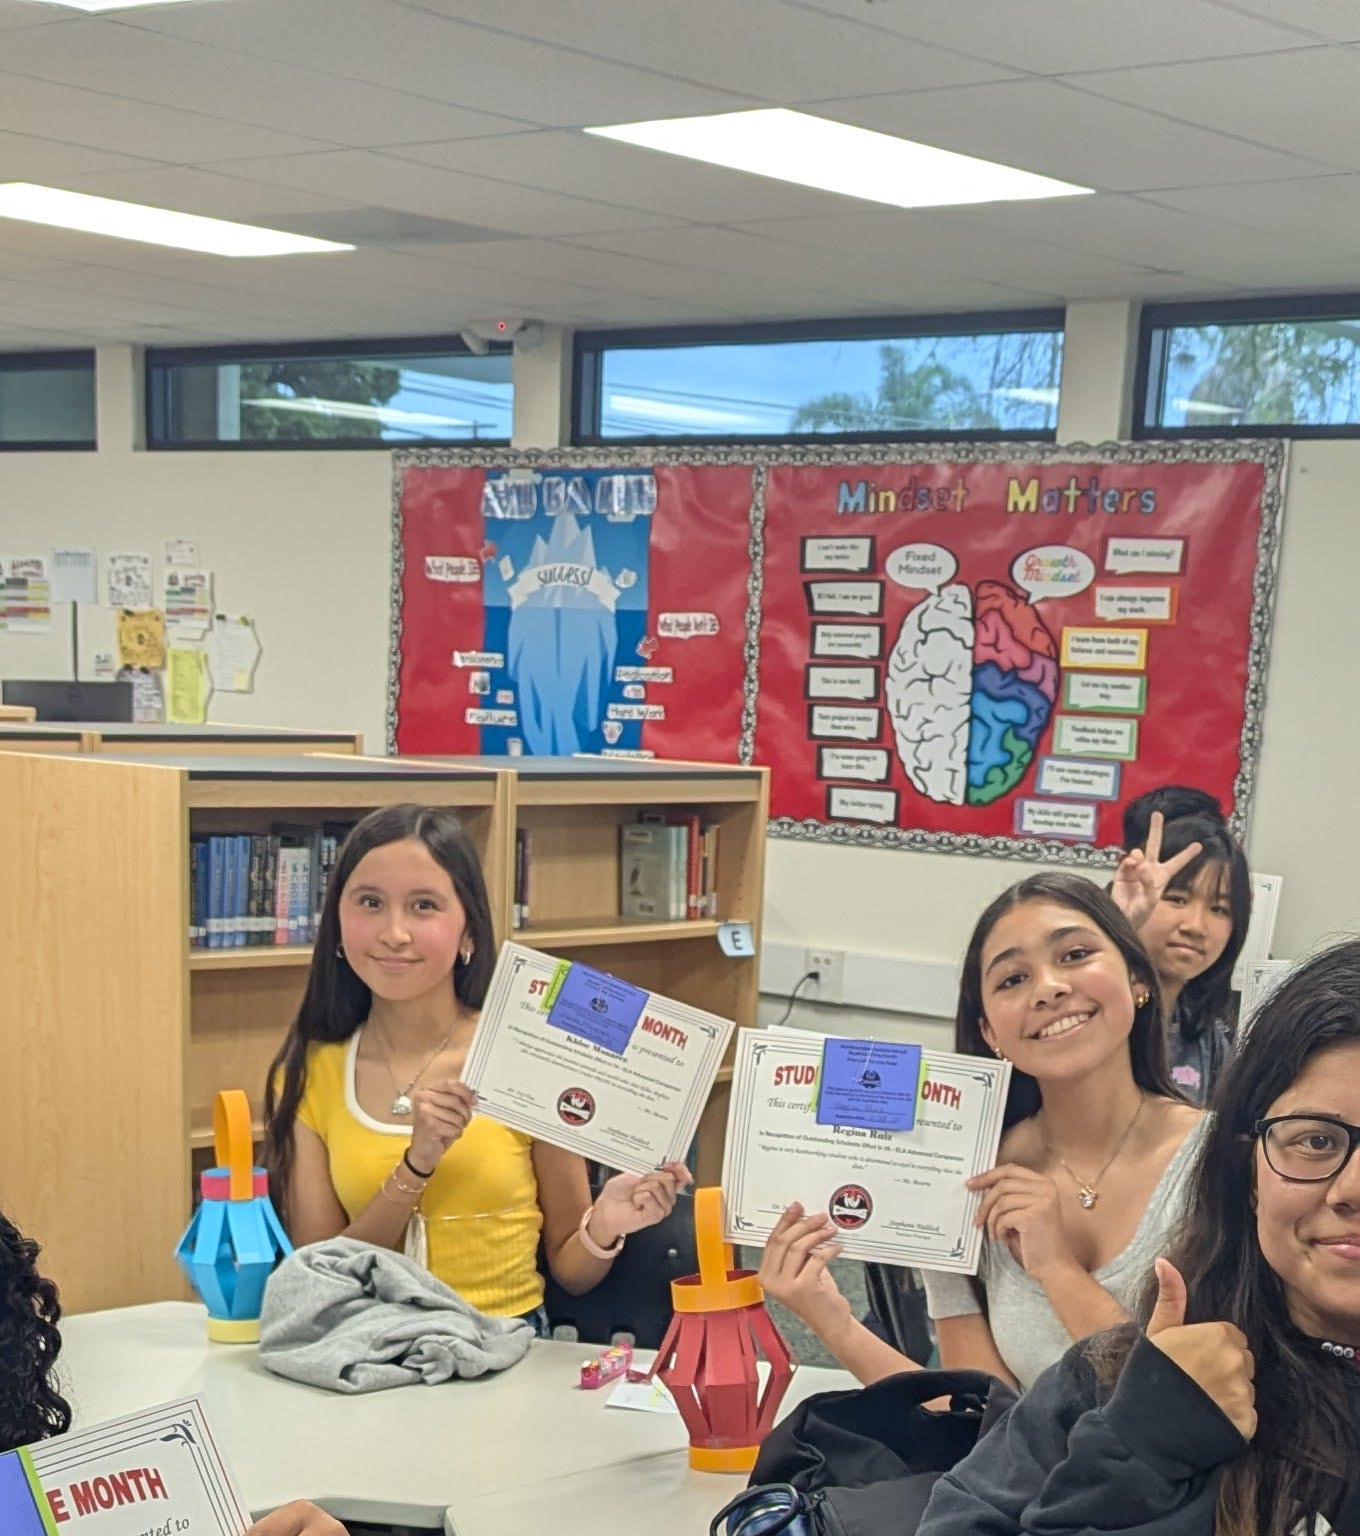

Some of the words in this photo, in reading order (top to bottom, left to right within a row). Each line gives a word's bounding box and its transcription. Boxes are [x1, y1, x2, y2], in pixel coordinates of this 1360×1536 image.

[837, 476, 969, 513] Mindset
[1006, 475, 1156, 513] Matters
[905, 550, 936, 561] Fixed
[898, 564, 942, 575] Mindset
[731, 931, 743, 950] E
[642, 1015, 688, 1050] MONTH
[766, 1096, 789, 1109] This
[920, 1080, 962, 1110] ONTH
[832, 1124, 867, 1140] Regina
[869, 1129, 893, 1142] Ruiz
[950, 1121, 963, 1131] to
[69, 1467, 169, 1517] MONTH
[175, 1518, 190, 1532] to
